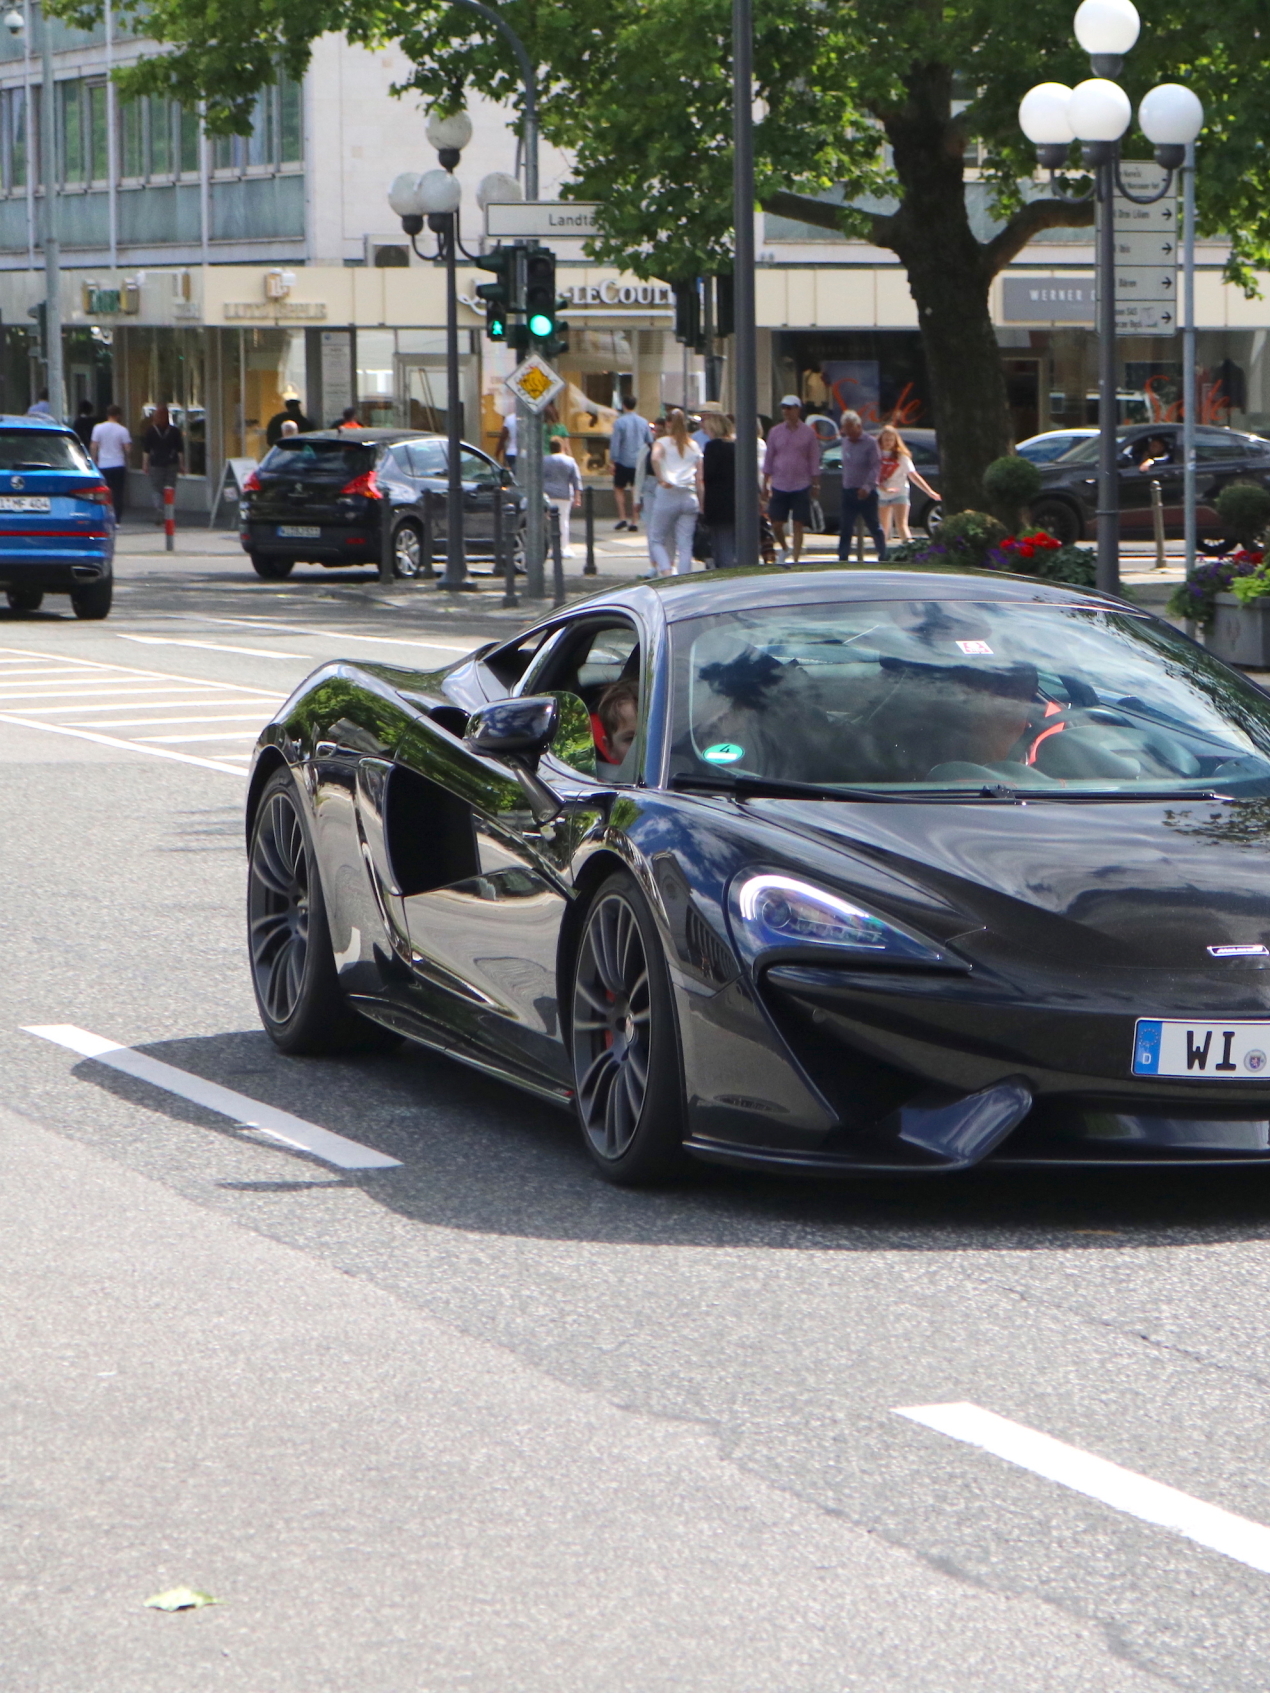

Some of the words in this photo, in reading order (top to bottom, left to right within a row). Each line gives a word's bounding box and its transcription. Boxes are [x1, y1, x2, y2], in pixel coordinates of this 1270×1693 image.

[550, 213, 599, 227] Landta
[1029, 289, 1081, 301] WERNER
[814, 377, 928, 436] Sale
[719, 744, 731, 755] 4
[1142, 1053, 1152, 1065] D
[1186, 1030, 1237, 1071] WI
